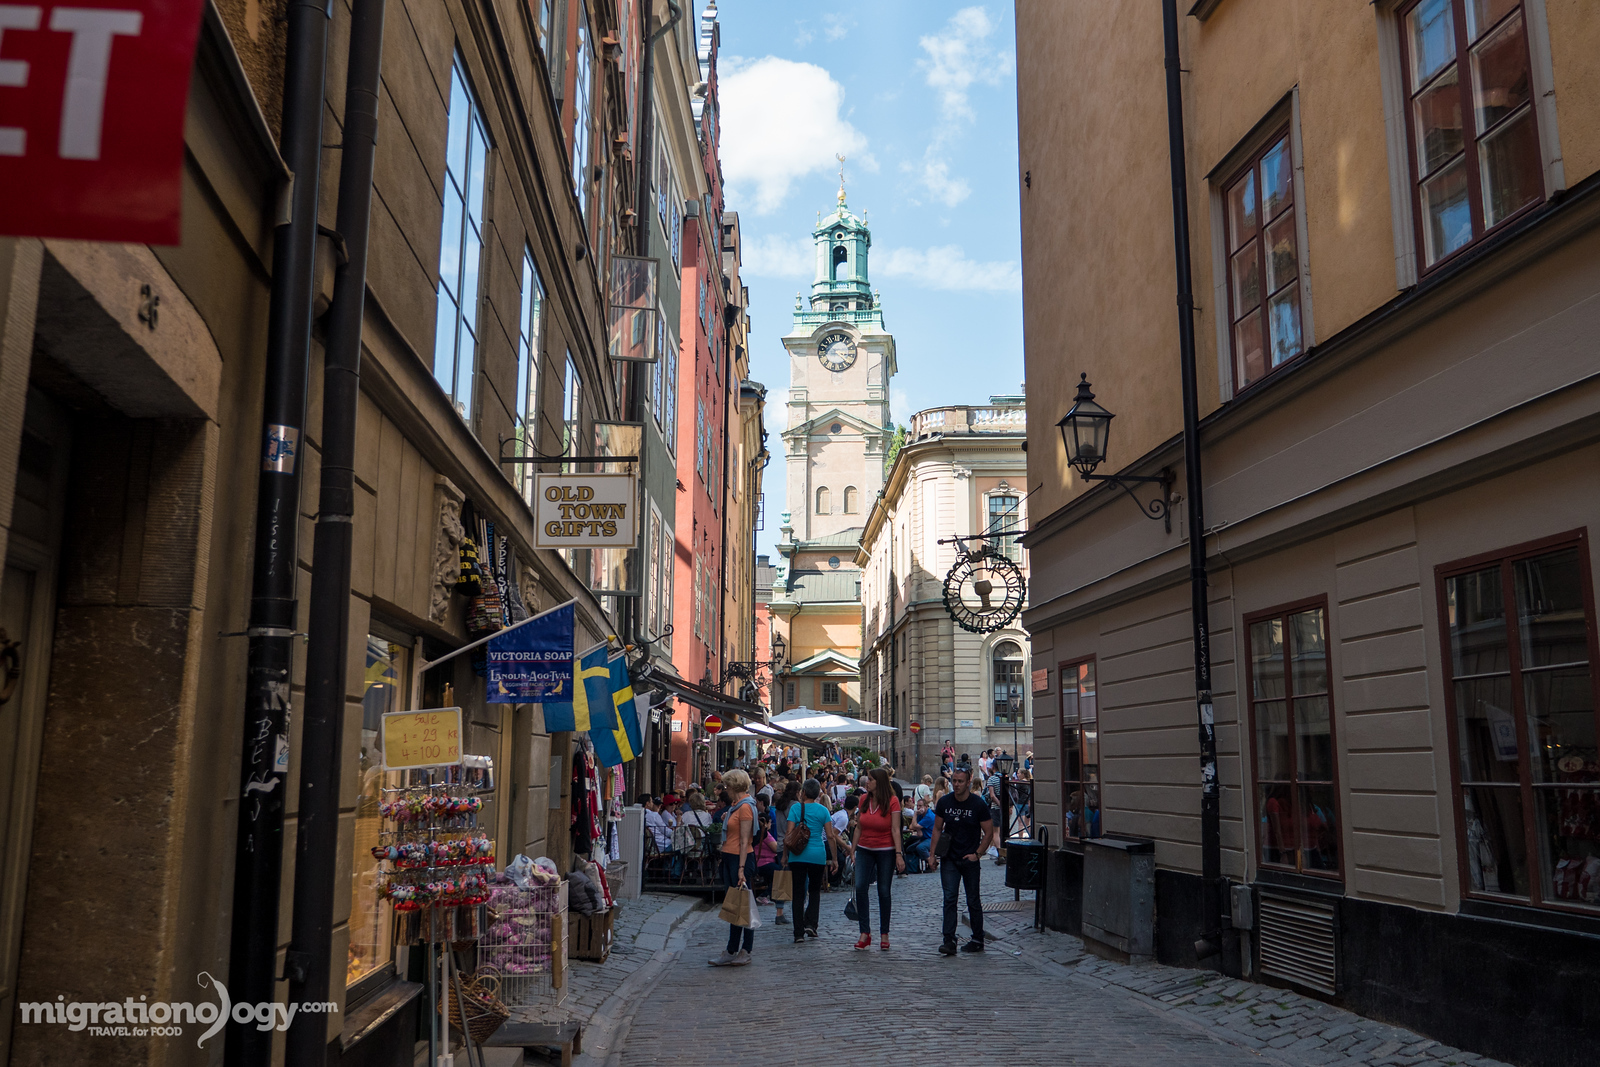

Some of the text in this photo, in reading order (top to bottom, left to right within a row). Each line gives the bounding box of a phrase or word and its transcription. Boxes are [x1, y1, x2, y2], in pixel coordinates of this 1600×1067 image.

[545, 486, 594, 502] OLD
[558, 503, 626, 519] TOWN
[545, 521, 617, 537] GIFTS
[490, 651, 572, 661] VICTORIA SOAP
[414, 713, 439, 726] Sale
[403, 733, 408, 743] 1
[423, 728, 437, 742] 29
[448, 729, 458, 739] KR
[402, 748, 410, 760] 4
[420, 745, 440, 759] 100
[448, 746, 458, 756] KR
